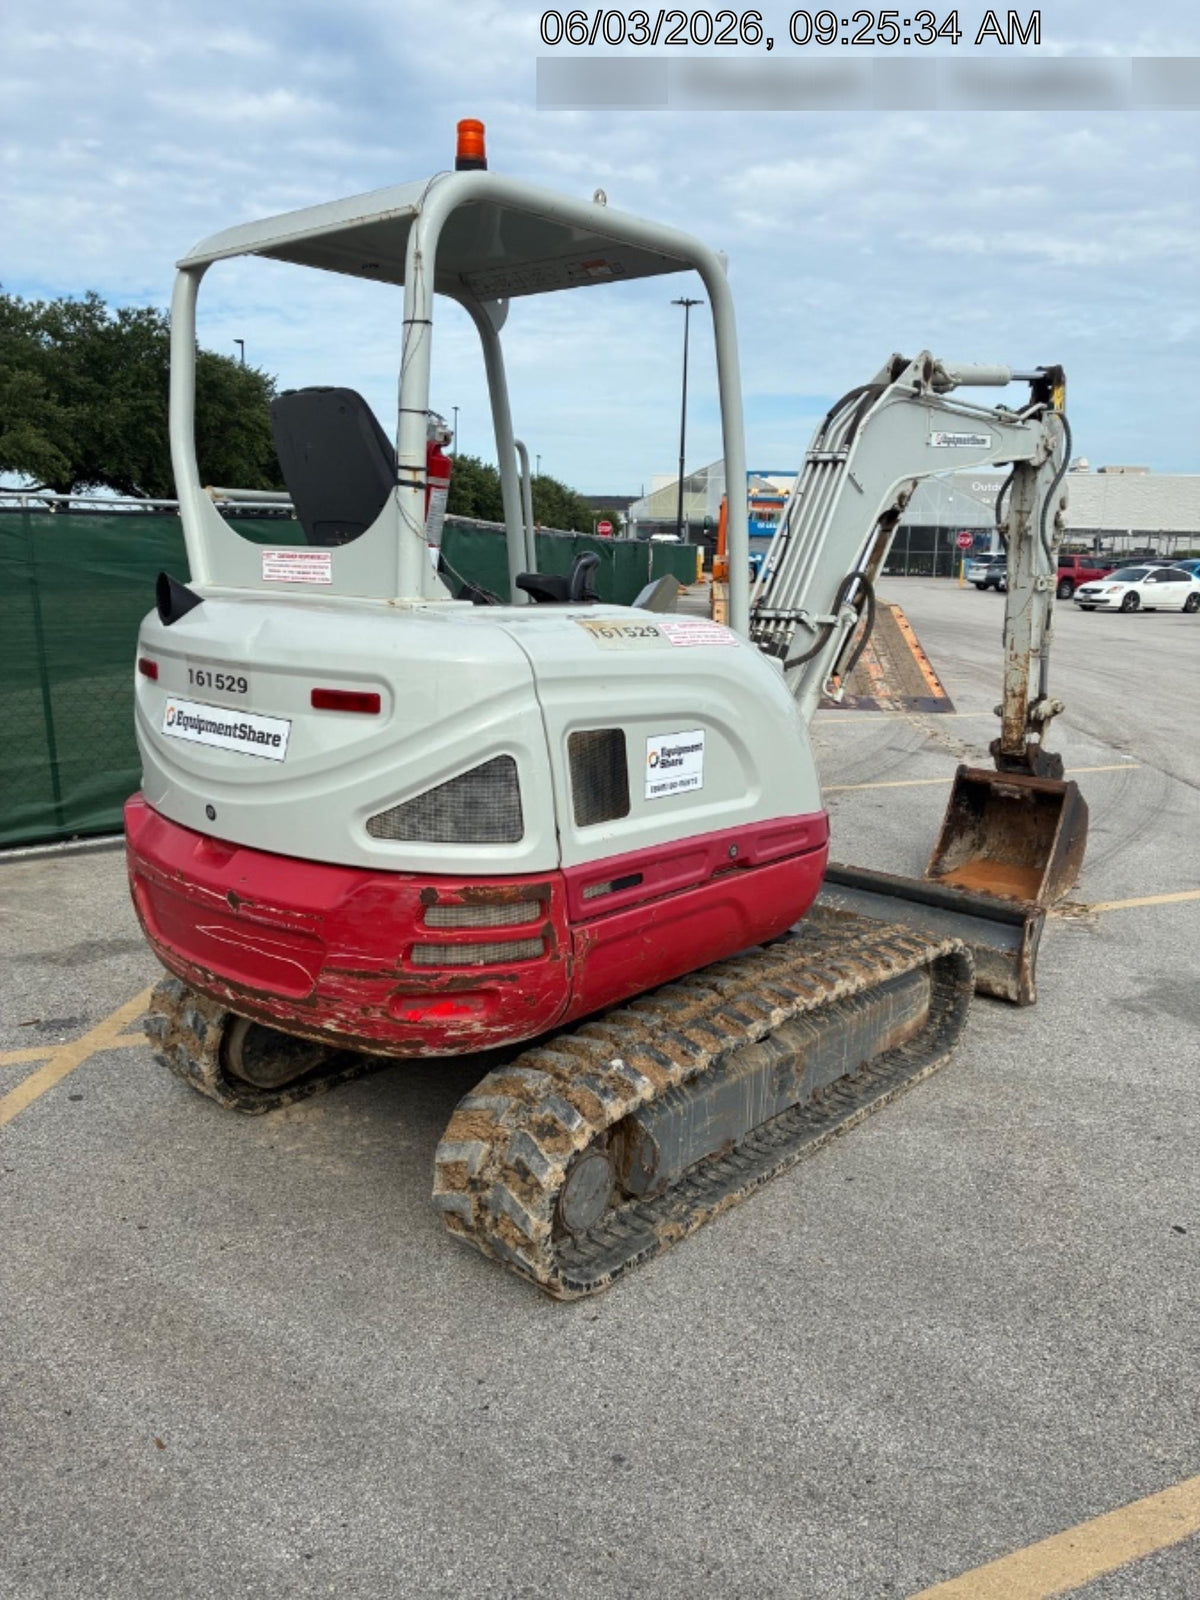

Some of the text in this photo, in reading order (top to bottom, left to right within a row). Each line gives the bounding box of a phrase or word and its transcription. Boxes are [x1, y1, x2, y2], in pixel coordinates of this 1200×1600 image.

[588, 626, 660, 639] 161529
[188, 668, 248, 694] 161529
[176, 710, 282, 747] EquipmentShare
[661, 743, 702, 757] Equipment
[660, 758, 684, 769] Share
